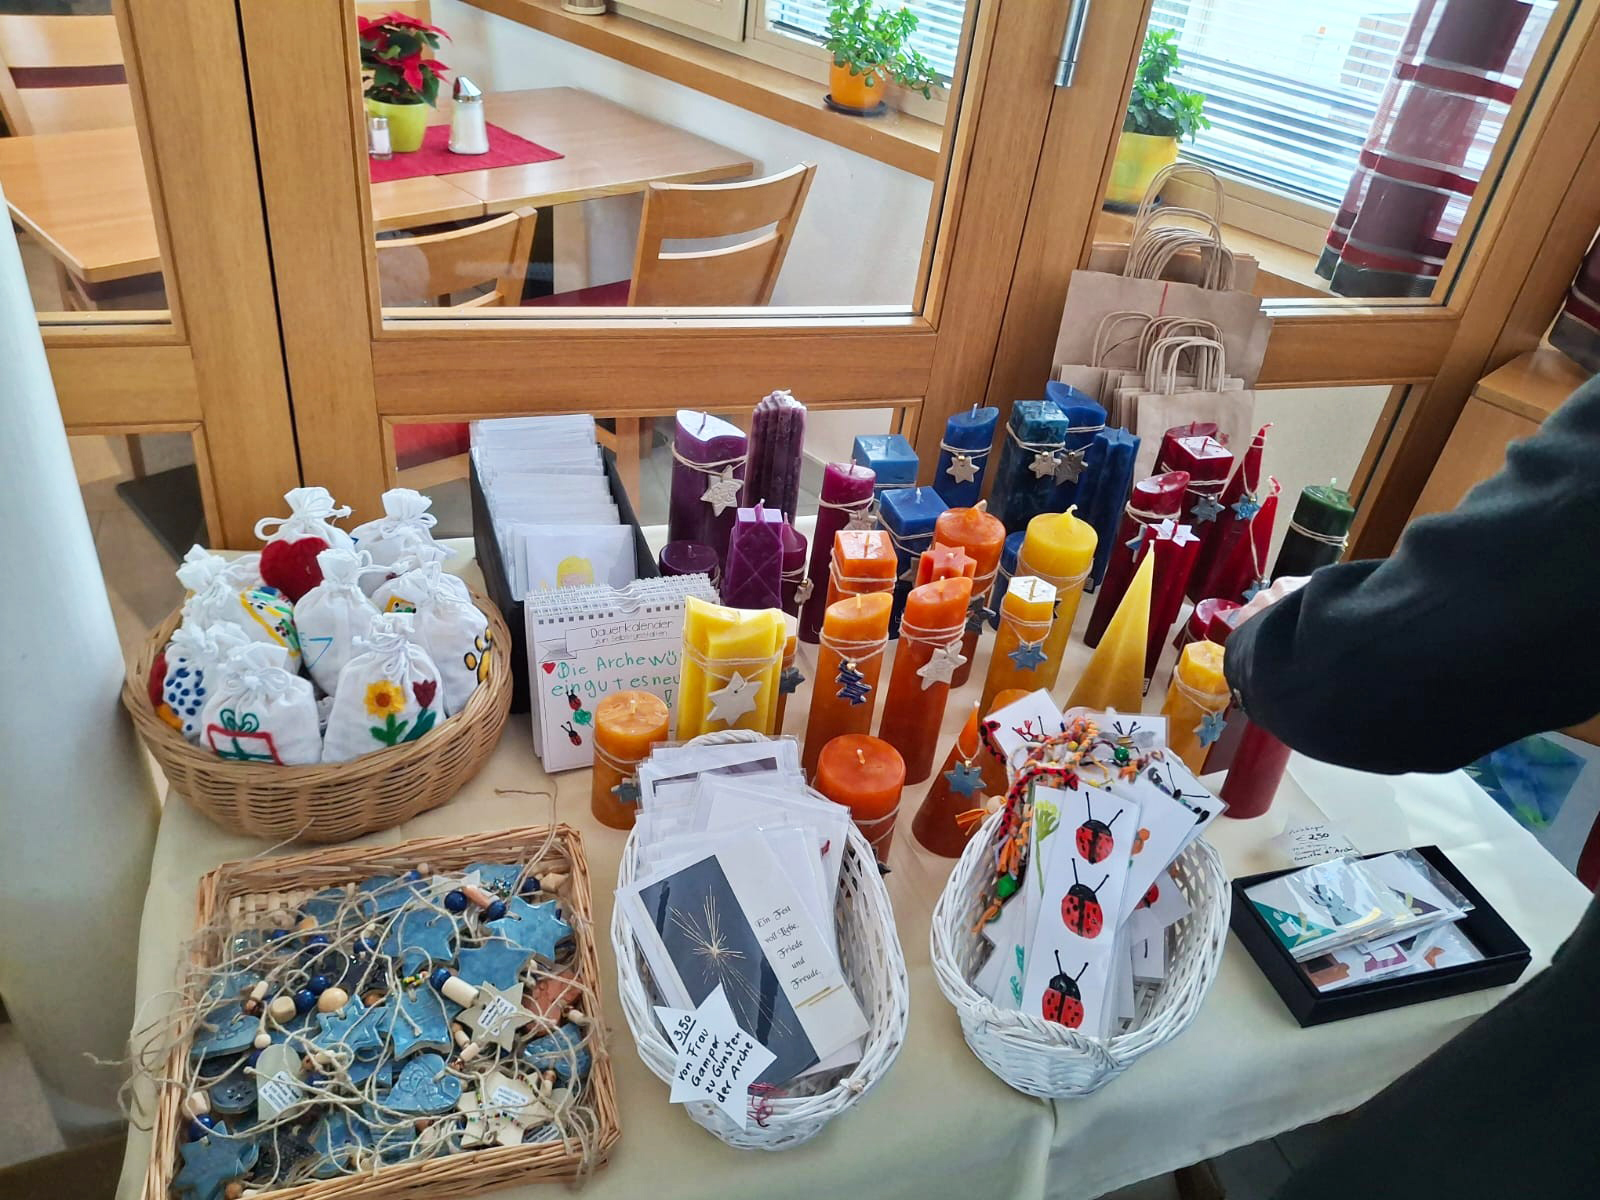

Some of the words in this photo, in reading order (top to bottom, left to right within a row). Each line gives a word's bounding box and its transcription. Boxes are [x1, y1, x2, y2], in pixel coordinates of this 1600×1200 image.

[590, 620, 673, 638] Dauerkalender
[557, 661, 588, 679] Die
[757, 916, 770, 928] Ein
[773, 906, 791, 921] Fest
[764, 931, 778, 944] voll
[777, 940, 803, 959] Friede
[791, 955, 806, 969] und
[673, 1015, 692, 1041] 3,50
[678, 1062, 693, 1081] von
[686, 1028, 709, 1057] Frau
[691, 1032, 720, 1087] Gamper
[705, 1079, 716, 1094] zu
[712, 1031, 742, 1078] Gunsten
[716, 1079, 732, 1103] der
[731, 1041, 754, 1080] Arche
